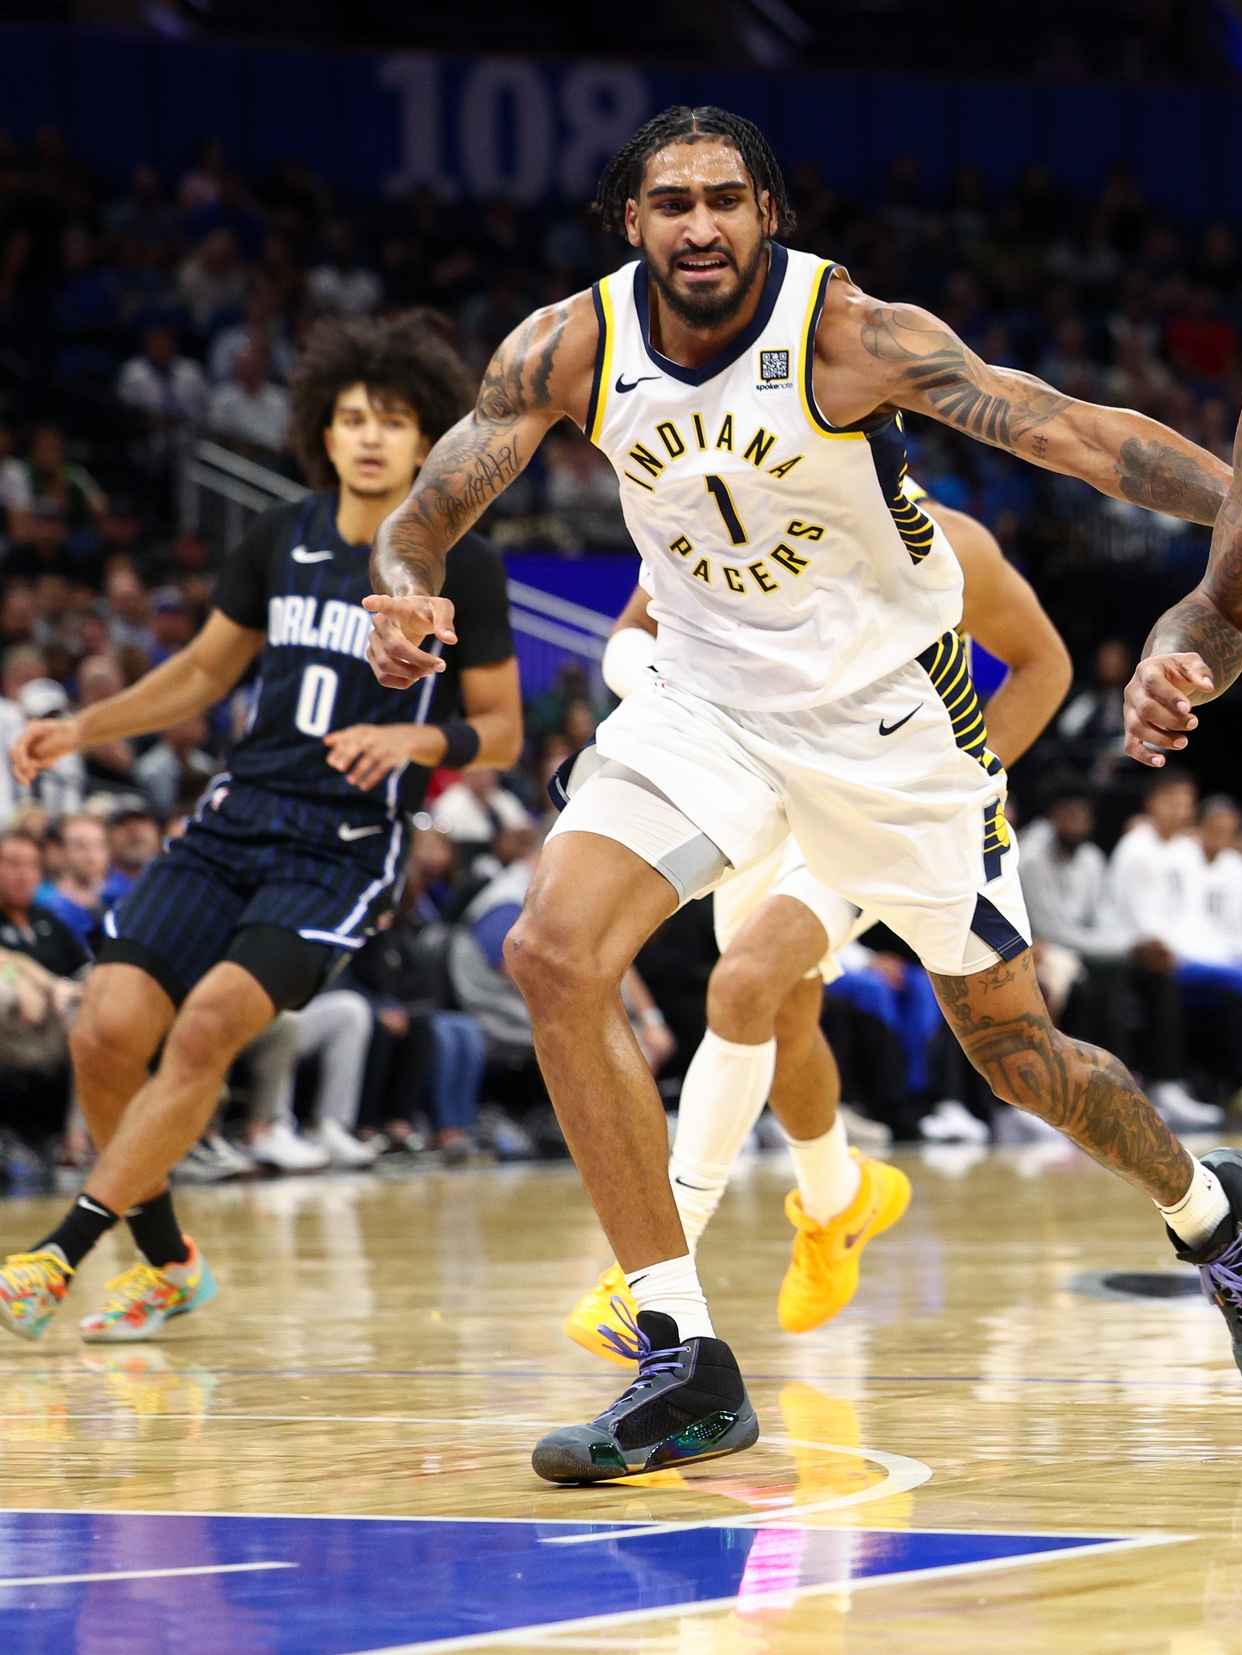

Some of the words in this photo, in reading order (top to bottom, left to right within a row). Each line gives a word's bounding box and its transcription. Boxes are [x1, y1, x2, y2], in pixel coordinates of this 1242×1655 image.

[378, 53, 647, 203] 108
[755, 383, 794, 392] spokenote
[624, 411, 806, 493] INDIANA
[703, 474, 751, 547] 1
[669, 518, 827, 595] PACERS
[267, 595, 373, 663] ORLAN
[295, 663, 339, 738] 0
